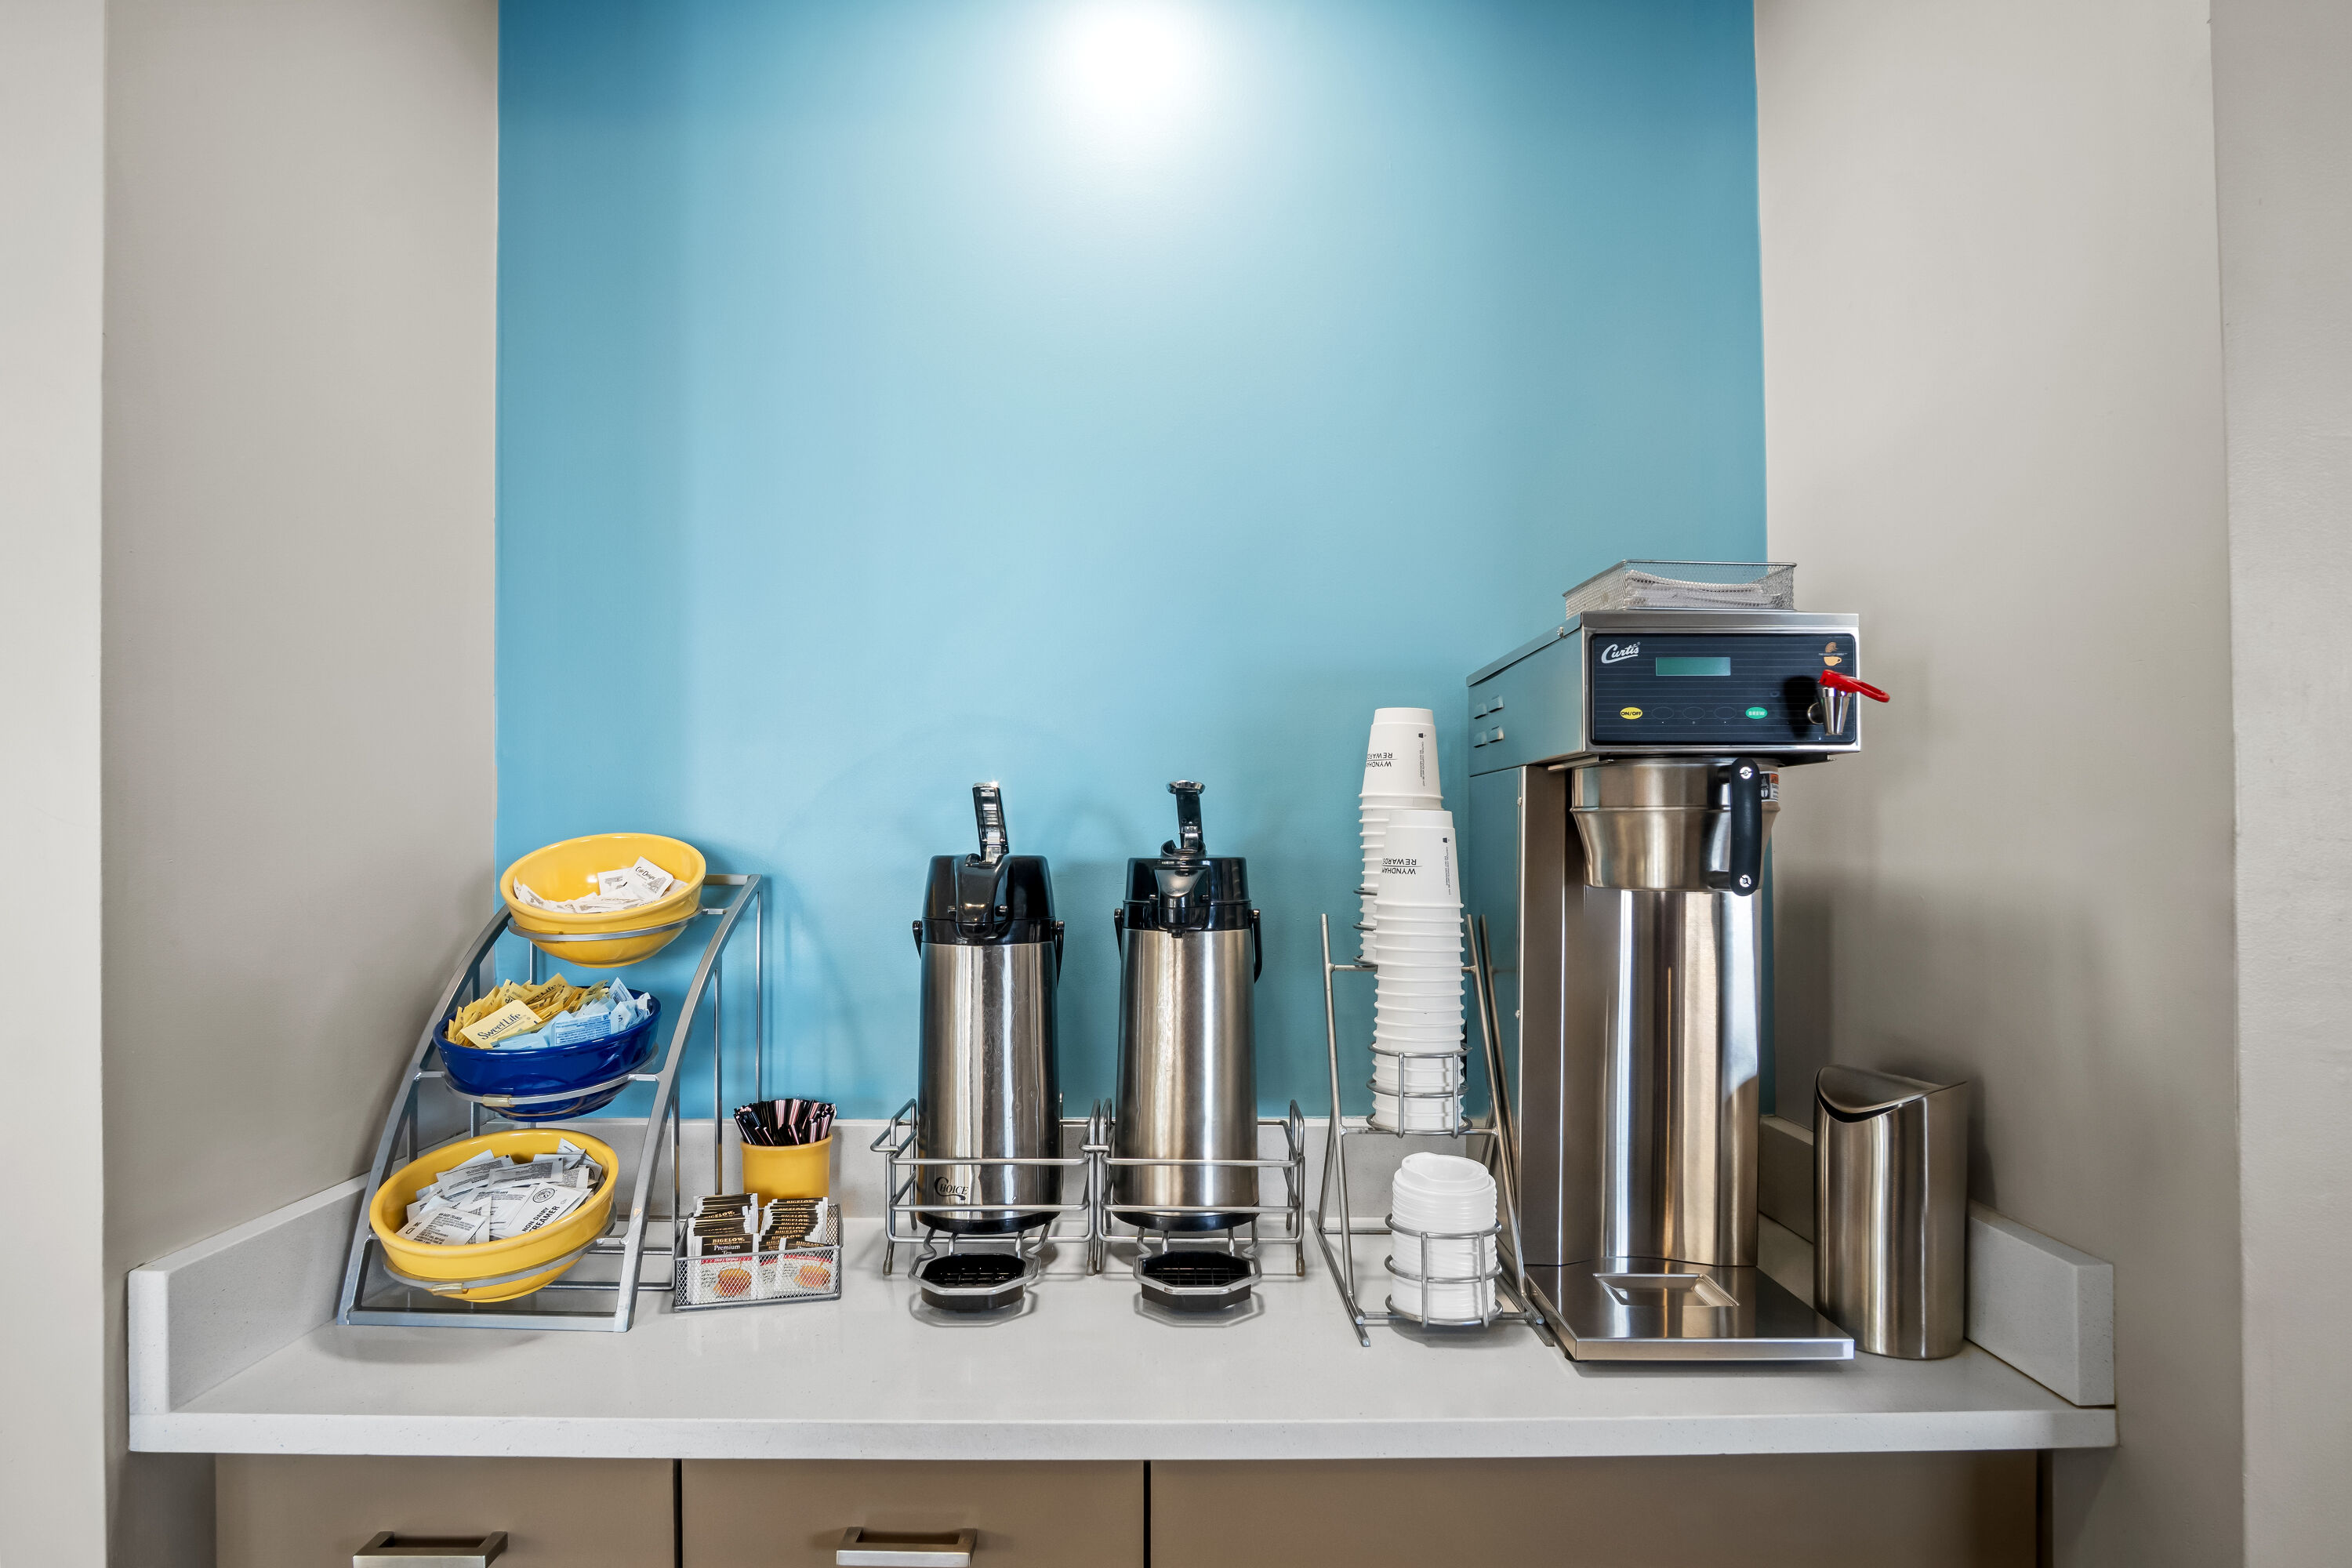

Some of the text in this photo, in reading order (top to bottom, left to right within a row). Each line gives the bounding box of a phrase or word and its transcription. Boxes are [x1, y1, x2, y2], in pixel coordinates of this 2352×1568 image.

[1601, 643, 1639, 664] Curtis
[477, 1013, 521, 1040] Sweet Life
[521, 1207, 550, 1232] NON-DAIRY
[528, 1206, 561, 1232] REAMER
